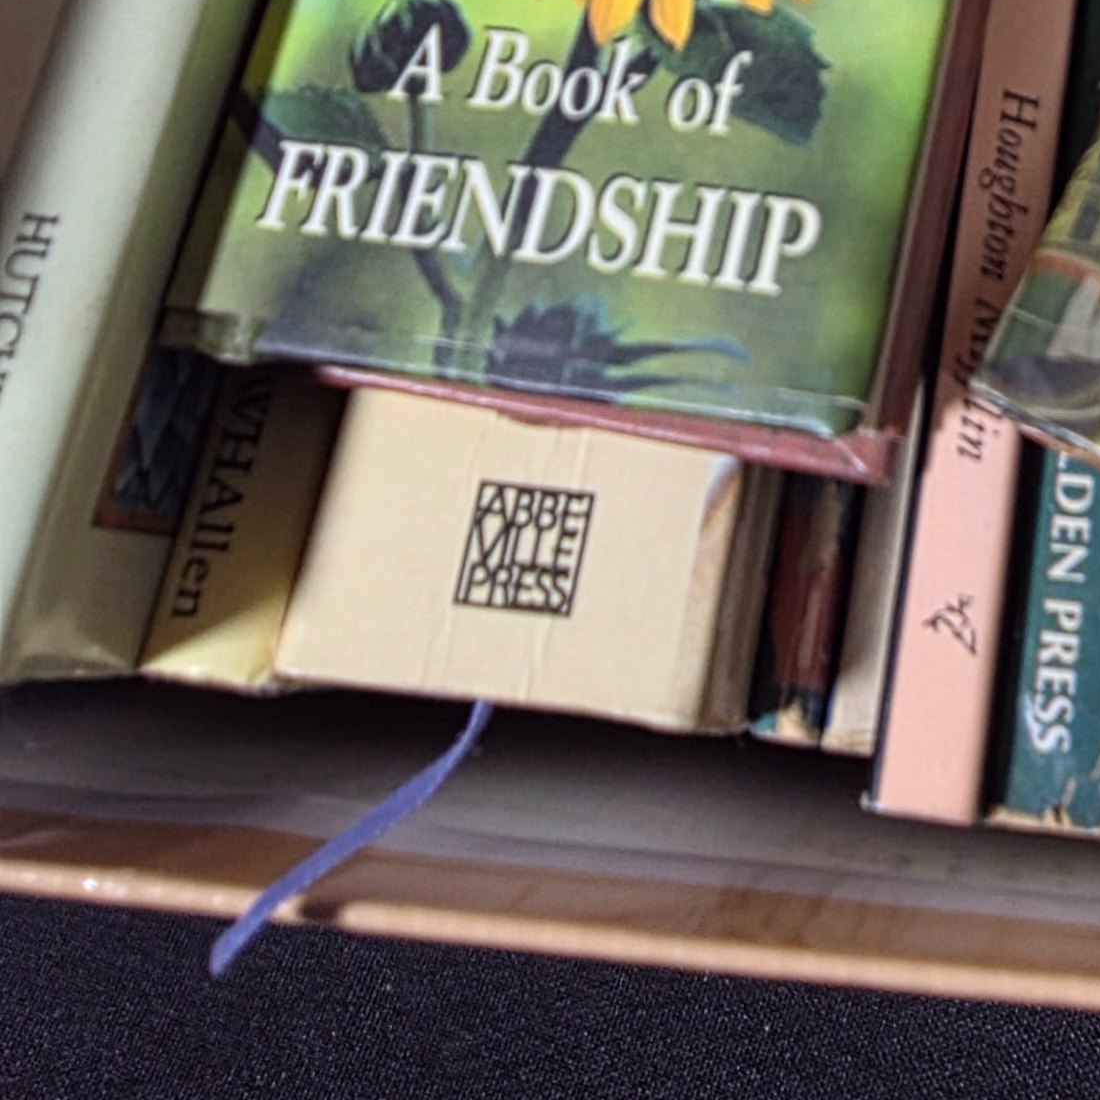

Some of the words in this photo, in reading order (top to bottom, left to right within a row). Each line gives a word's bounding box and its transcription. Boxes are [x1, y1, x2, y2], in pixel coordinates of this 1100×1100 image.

[387, 22, 444, 101] A
[468, 26, 648, 126] Book
[667, 49, 752, 137] of
[257, 138, 823, 296] FRIENDSHIP
[978, 87, 1041, 281] Houghton
[0, 212, 60, 396] HUTC
[1046, 451, 1096, 585] DEN
[1030, 596, 1084, 756] PRESS
